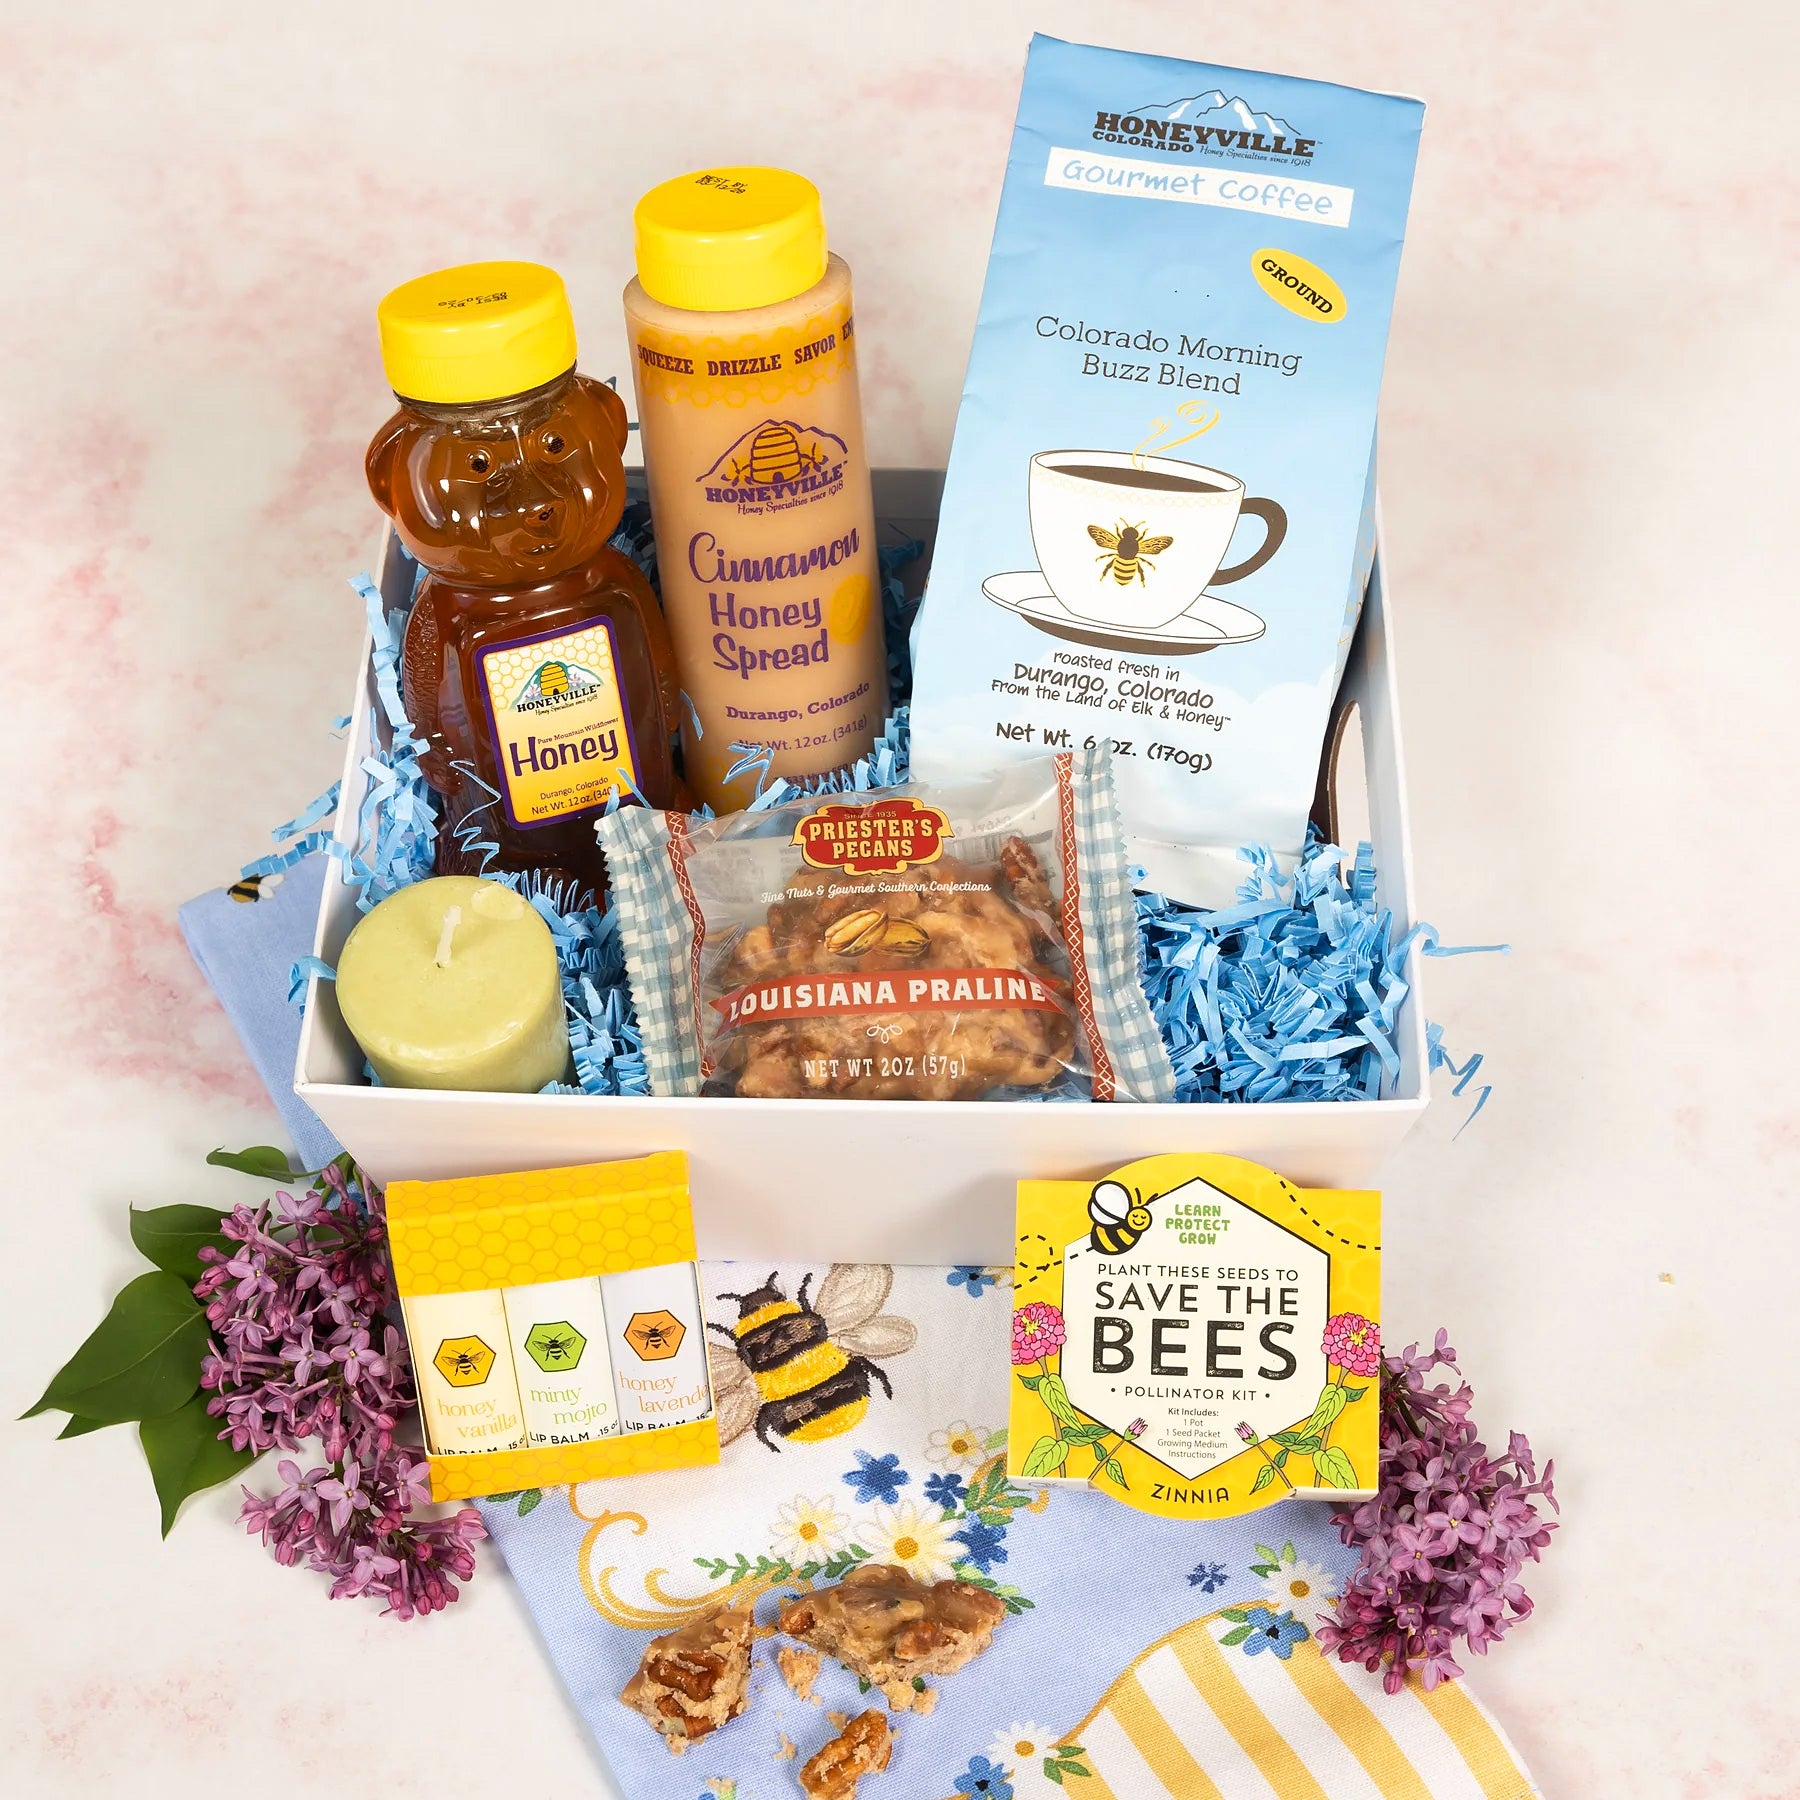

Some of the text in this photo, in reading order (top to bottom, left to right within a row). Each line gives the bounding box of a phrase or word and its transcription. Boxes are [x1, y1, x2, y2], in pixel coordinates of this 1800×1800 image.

[1094, 111, 1316, 158] HONEYVILLE
[1092, 131, 1312, 167] COLORADO Honey Specialties since 1918
[1062, 159, 1333, 215] Gourmet Coffee
[1261, 258, 1333, 315] GROUND
[637, 344, 694, 375] SQUEEZE
[707, 354, 782, 376] DRIZZLE
[794, 334, 836, 365] SAVOR
[1035, 315, 1303, 377] Colorado Morning
[1082, 353, 1241, 395] Buzz Blend
[705, 463, 843, 504] HONEYVILLE
[738, 480, 844, 516] Honey Specialties since 1918
[689, 527, 860, 583] Cinnamon
[709, 593, 822, 630] Honey
[713, 628, 829, 680] Spread
[1053, 651, 1180, 682] roasted fresh in
[991, 679, 1029, 697] From
[1036, 685, 1061, 701] the
[1066, 691, 1103, 708] Land
[1108, 697, 1127, 712] of
[1131, 700, 1153, 716] Elk
[1159, 704, 1170, 719] &
[1014, 663, 1214, 709] Durango, Colorado
[516, 687, 598, 713] HONEYVILLE
[725, 681, 870, 723] Durango, Colorado
[554, 728, 585, 741] Mountain
[584, 717, 619, 732] Wildflower
[766, 739, 792, 751] Wt.
[795, 736, 811, 749] 12
[813, 734, 831, 744] oz.
[833, 715, 868, 741] (341g)
[509, 729, 619, 777] Honey
[996, 722, 1036, 743] Net
[1083, 735, 1097, 750] 6
[1147, 742, 1212, 774] (170g)
[531, 784, 620, 815] Net Wt. 12 oz. (340)
[540, 777, 609, 800] Durango, Colorado
[809, 819, 933, 842] PRIESTER'S
[833, 840, 913, 859] PECANS
[760, 880, 992, 904] Fine Nuts & Gourmet Southern Confections
[729, 977, 1046, 1023] LOUISIANA PRALINE
[804, 1059, 839, 1079] NET
[847, 1058, 873, 1078] WT
[922, 1054, 966, 1079] (57g)
[1175, 1204, 1222, 1217] LEARN
[1165, 1218, 1231, 1232] PROTECT
[1178, 1232, 1217, 1245] GROW
[1098, 1263, 1299, 1282] PLANT THESE SEEDS TO
[1095, 1281, 1299, 1316] SAVE THE
[1092, 1316, 1297, 1381] BEES
[619, 1370, 677, 1394] honey
[1125, 1386, 1257, 1401] POLLINATOR KIT
[437, 1398, 497, 1418] honey
[530, 1386, 583, 1406] minty
[1168, 1407, 1220, 1417] Kit Includes:
[1184, 1419, 1204, 1427] 1 Pot
[457, 1413, 518, 1439] vanilla
[530, 1431, 547, 1443] LIP
[551, 1432, 589, 1445] BALM
[625, 1420, 644, 1431] LIP
[1172, 1429, 1192, 1437] Seed
[1194, 1430, 1221, 1438] Packet
[1157, 1439, 1228, 1450] Growing Medium
[1168, 1450, 1216, 1459] Instructions
[1151, 1483, 1229, 1504] ZINNIA
